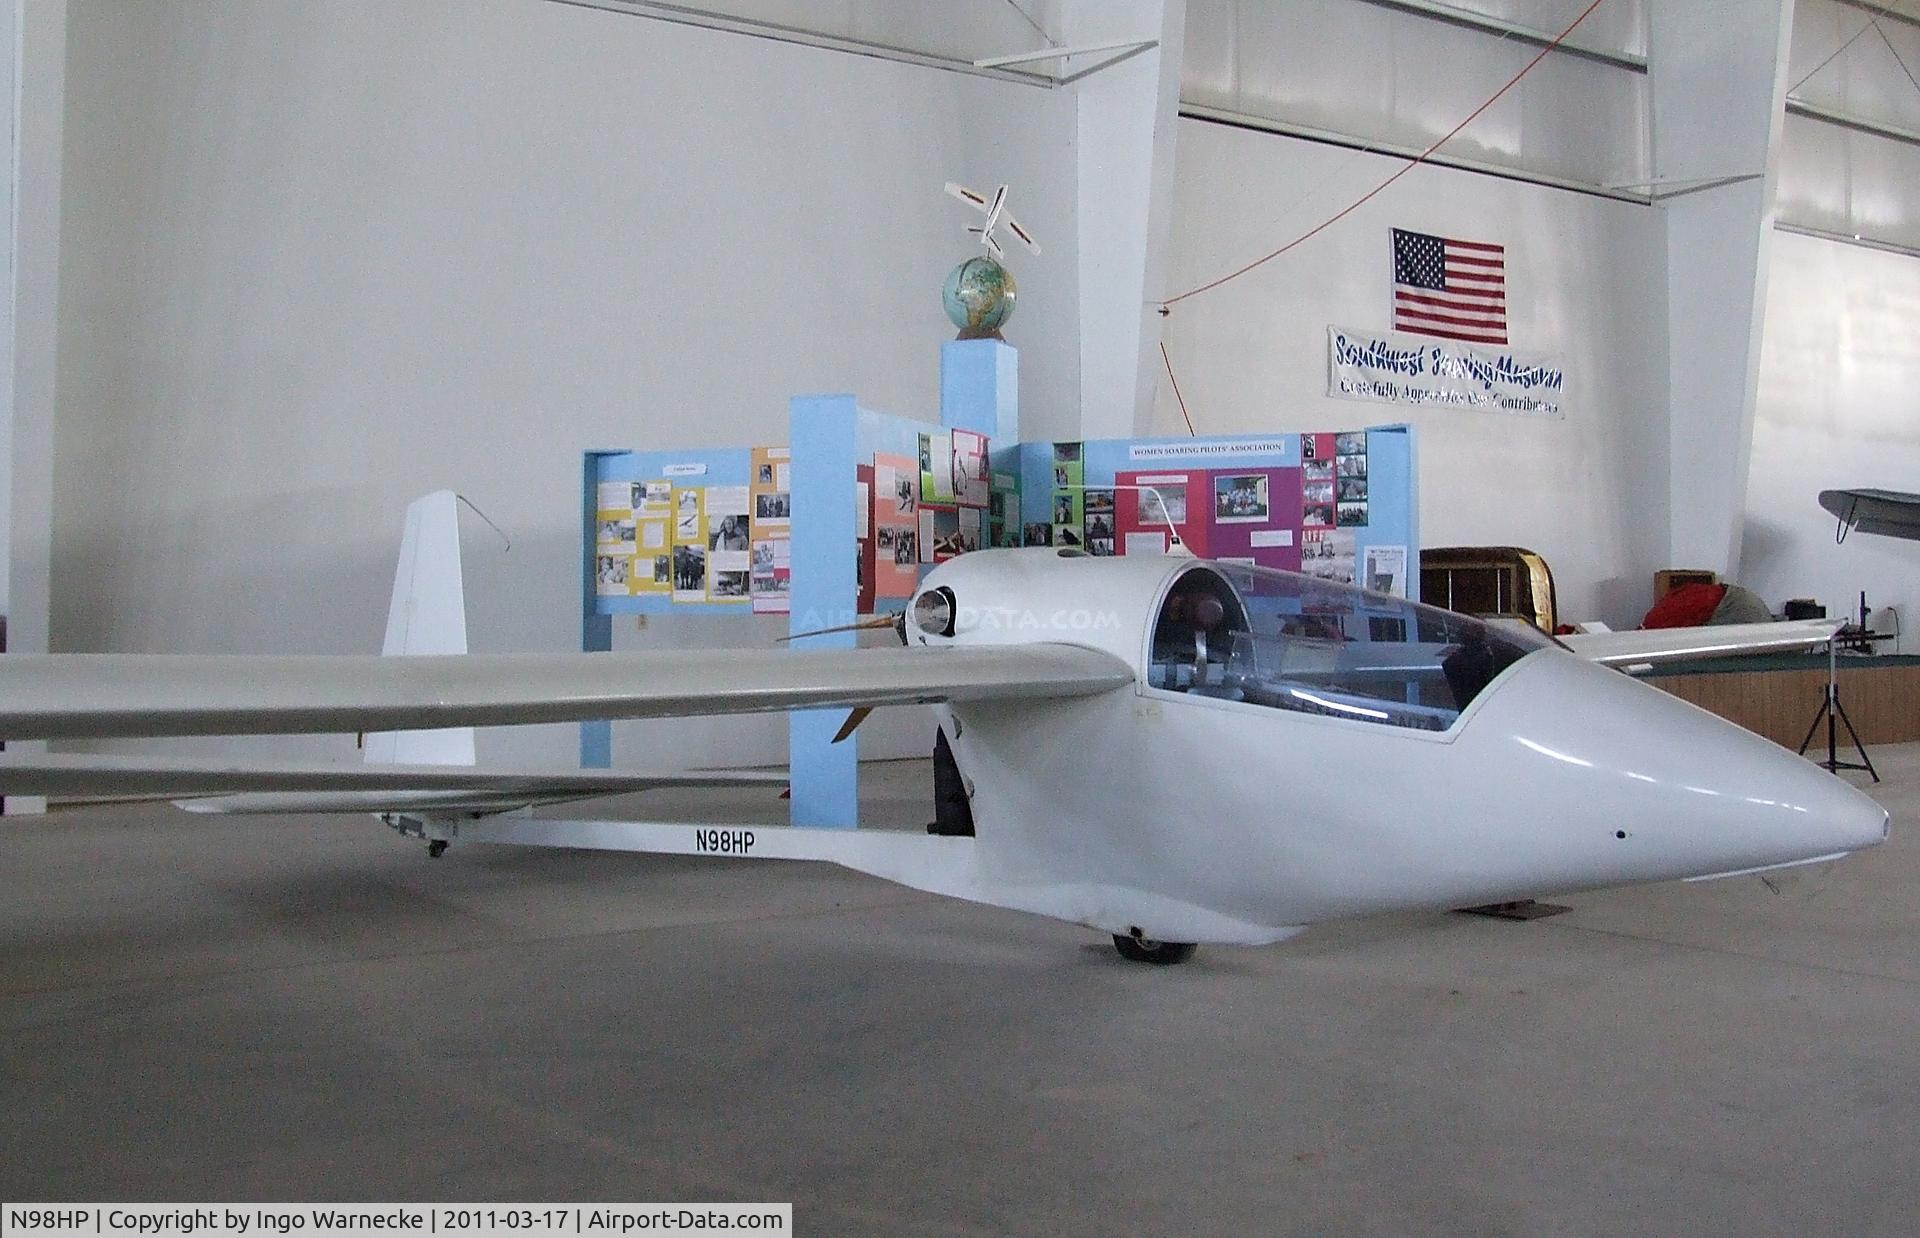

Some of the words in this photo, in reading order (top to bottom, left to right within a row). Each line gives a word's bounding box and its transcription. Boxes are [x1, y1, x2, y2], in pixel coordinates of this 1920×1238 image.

[1335, 334, 1425, 377] Southwest
[1134, 447, 1163, 456] WOMEN
[1164, 446, 1199, 455] SOARING
[1230, 443, 1281, 452] ASSOCIATION
[696, 829, 755, 854] N98HP
